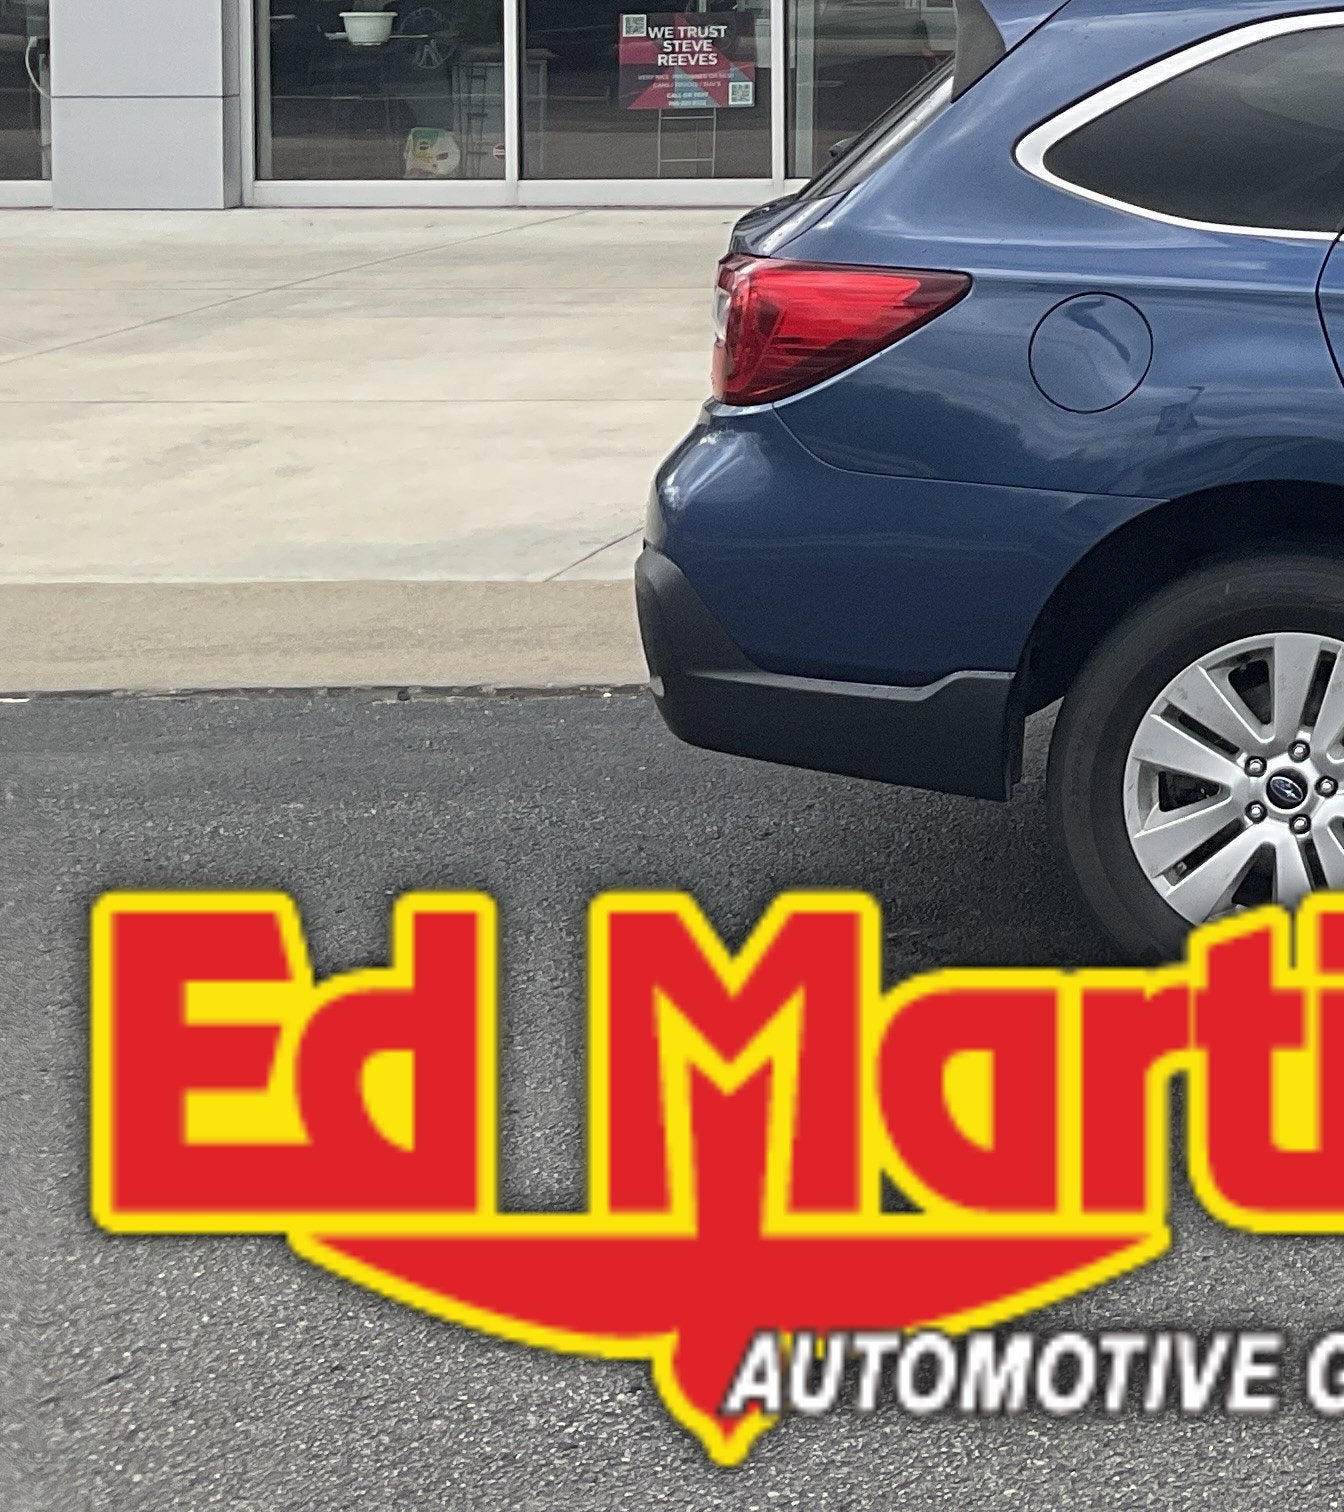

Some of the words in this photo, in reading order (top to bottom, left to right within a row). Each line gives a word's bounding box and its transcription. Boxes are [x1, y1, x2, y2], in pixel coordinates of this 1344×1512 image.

[648, 26, 674, 39] WE
[677, 25, 727, 38] TRUST
[662, 39, 713, 53] STEVE
[657, 52, 718, 67] REEVES
